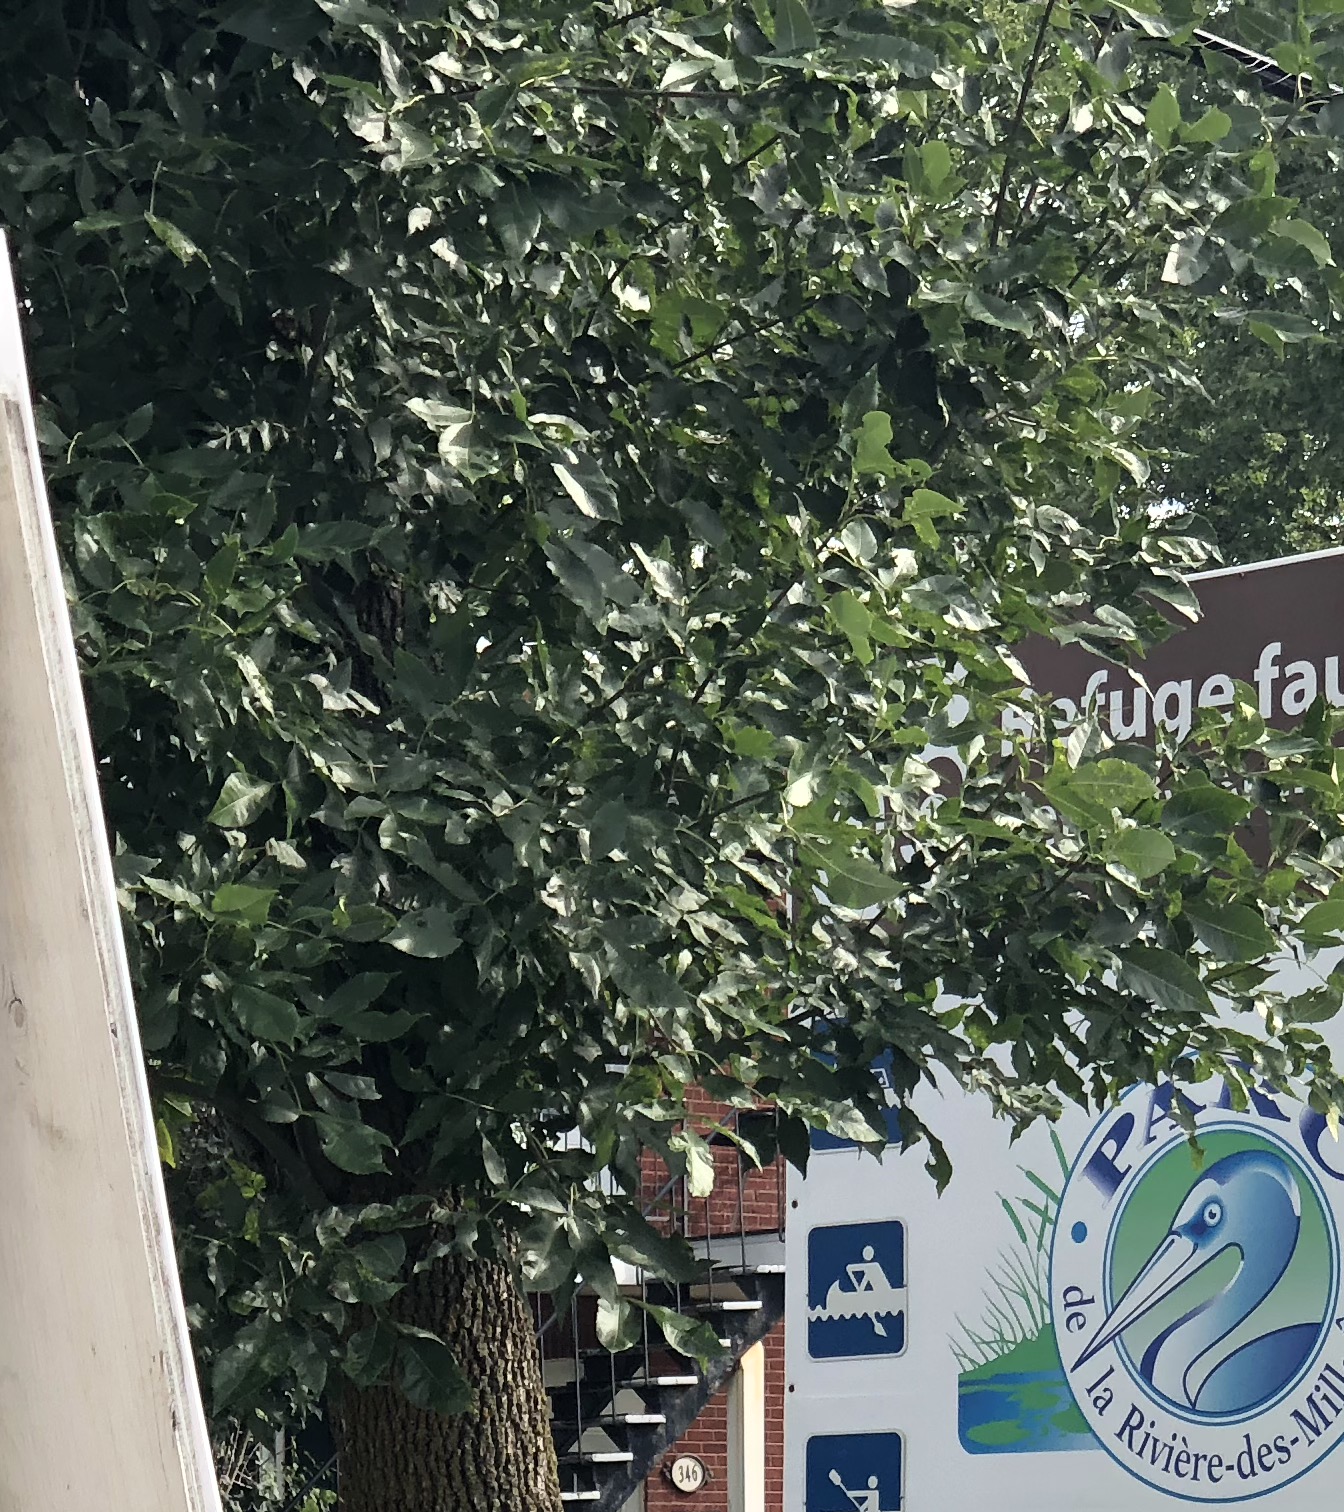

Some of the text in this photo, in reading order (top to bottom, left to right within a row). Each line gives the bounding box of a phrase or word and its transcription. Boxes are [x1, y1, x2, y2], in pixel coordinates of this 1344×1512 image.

[1061, 1284, 1096, 1334] de
[1084, 1365, 1112, 1417] la
[678, 1464, 698, 1483] 346
